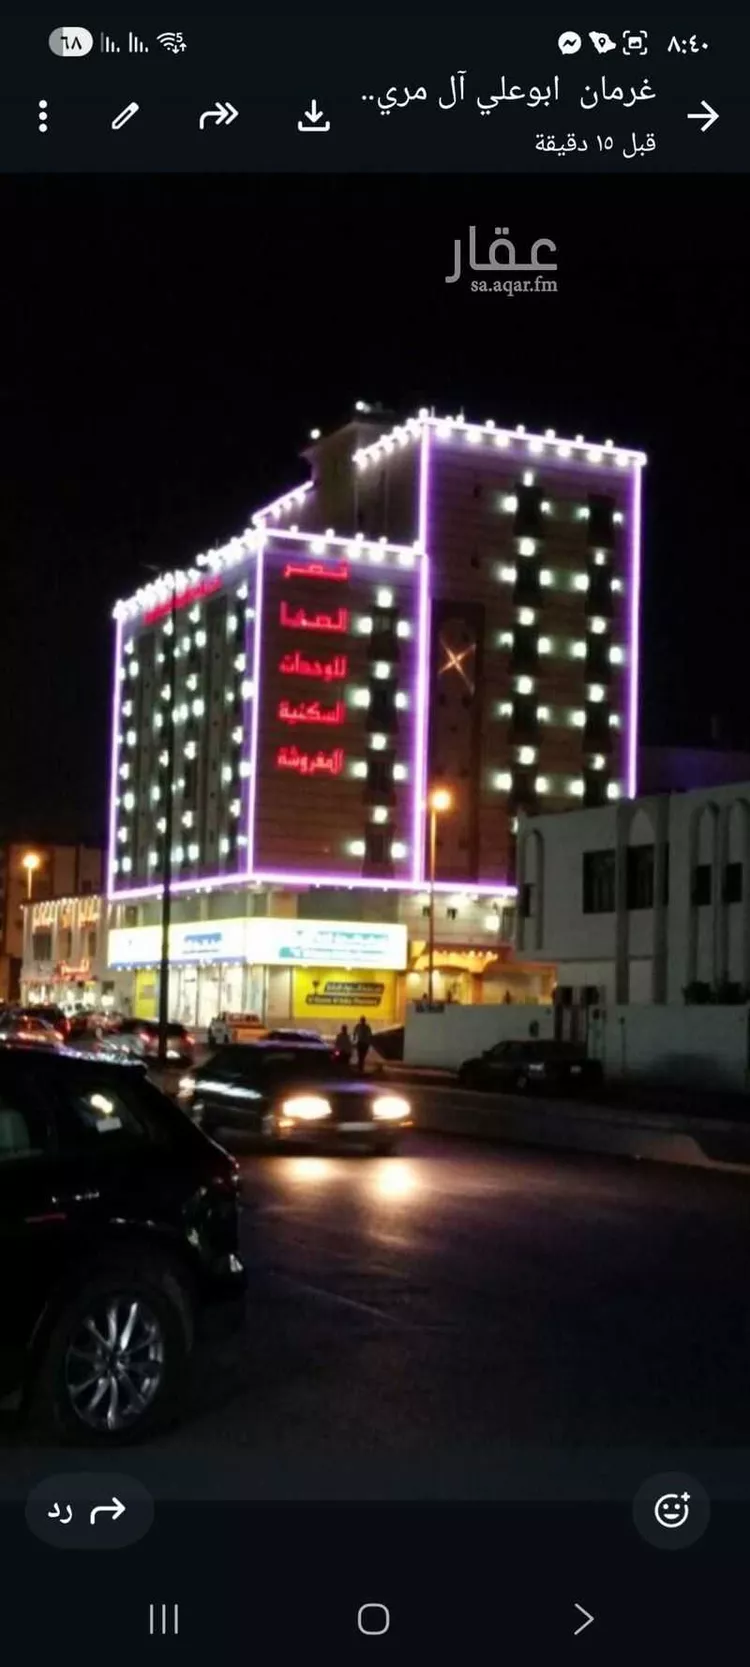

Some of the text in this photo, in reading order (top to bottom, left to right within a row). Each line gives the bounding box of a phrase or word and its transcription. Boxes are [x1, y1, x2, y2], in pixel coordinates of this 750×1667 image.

[279, 601, 349, 634] الصفا
[278, 700, 347, 727] السكنية
[276, 746, 345, 776] المفروشة
